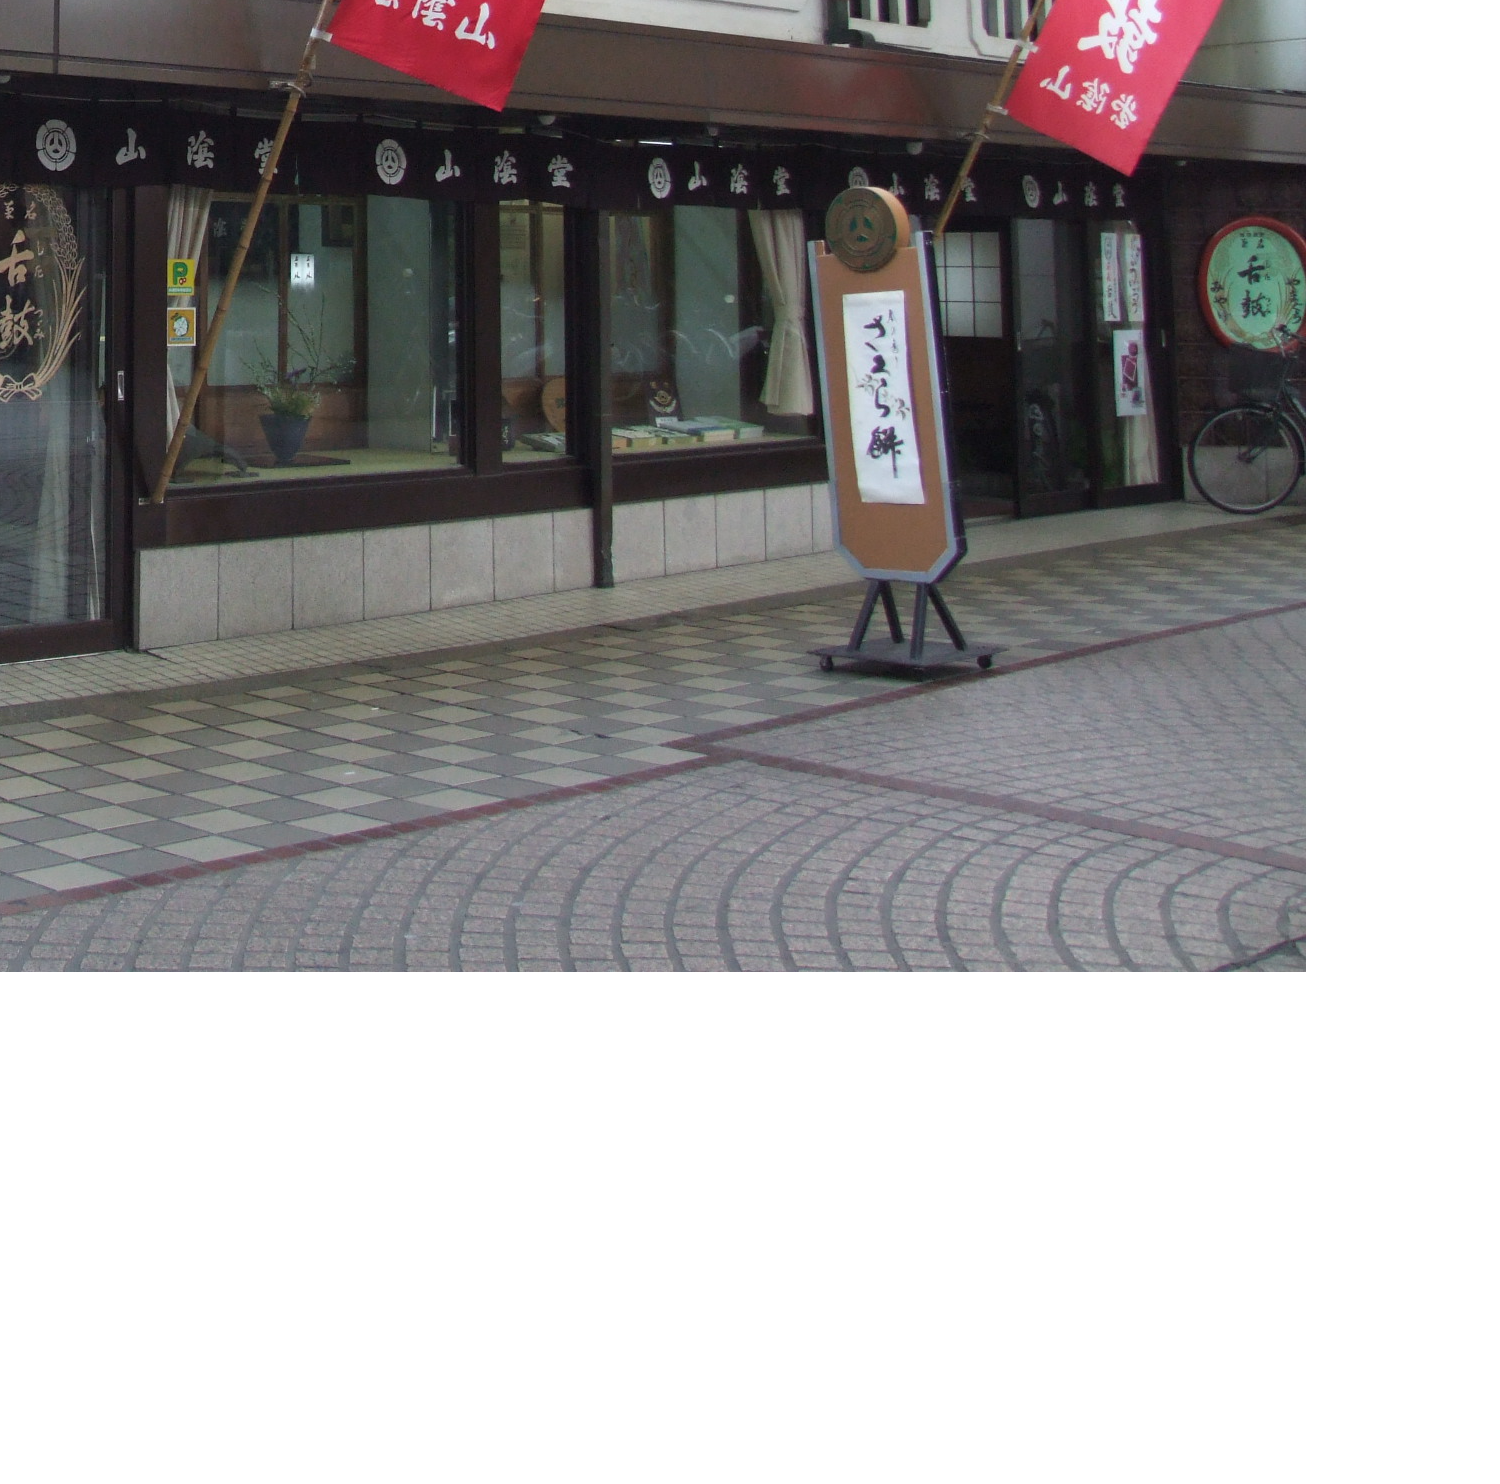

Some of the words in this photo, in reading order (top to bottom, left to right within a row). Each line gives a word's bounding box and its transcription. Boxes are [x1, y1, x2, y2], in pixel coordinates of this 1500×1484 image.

[435, 149, 573, 188] 山陰堂
[687, 161, 791, 197] 山陰堂
[1052, 181, 1126, 208] 山陰堂
